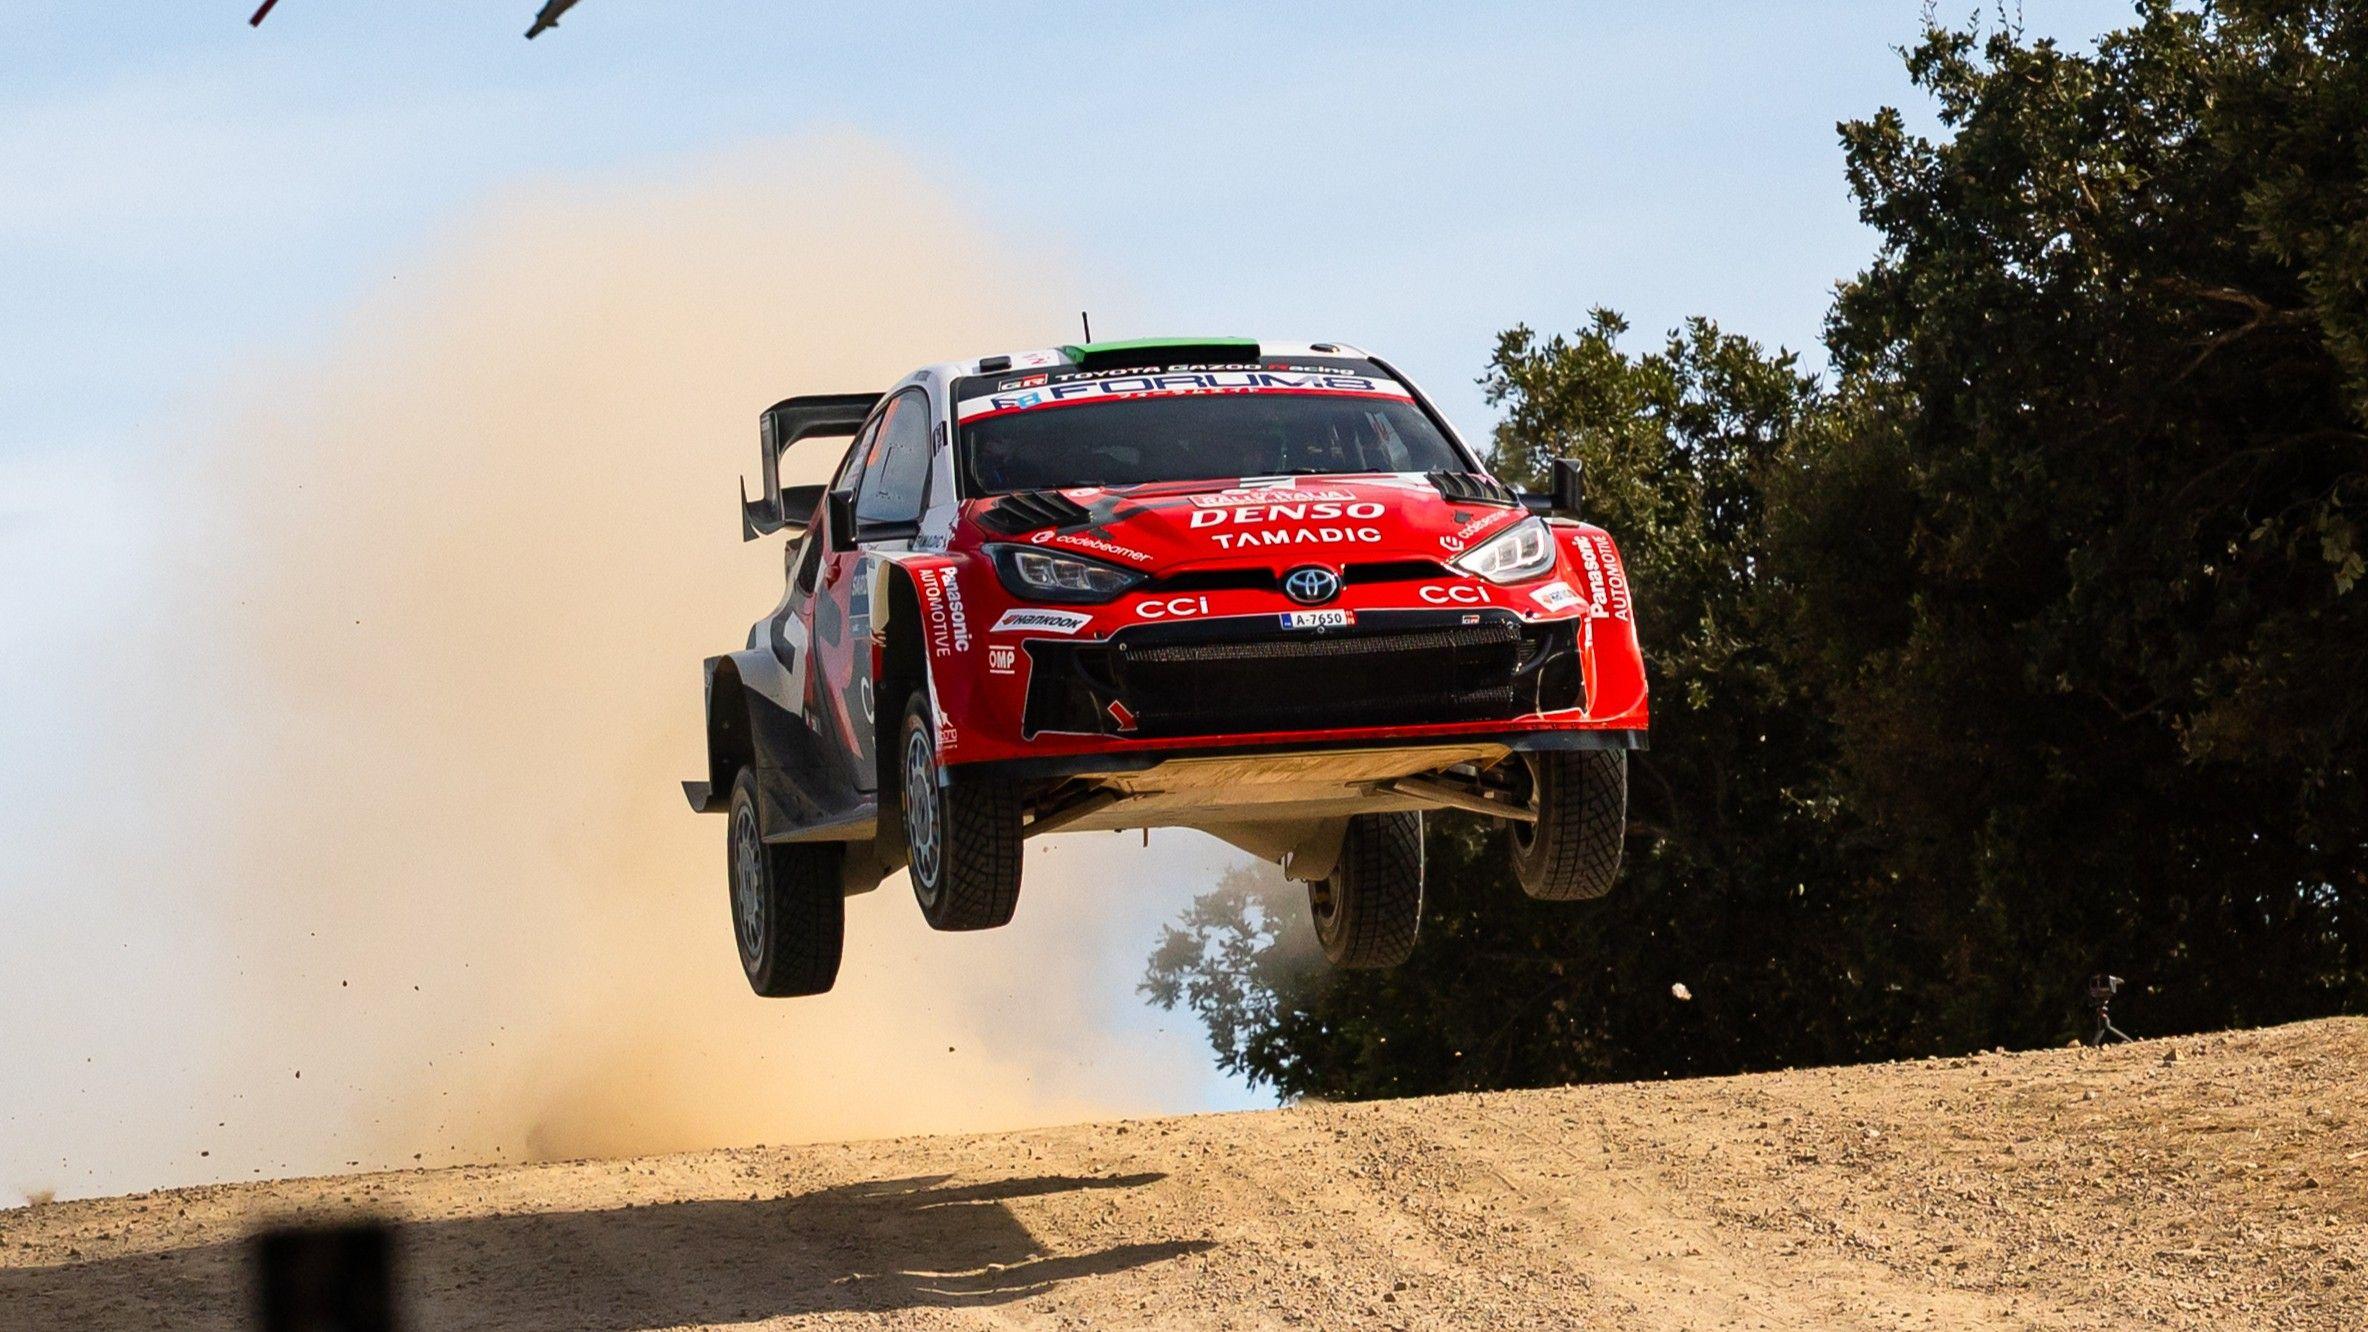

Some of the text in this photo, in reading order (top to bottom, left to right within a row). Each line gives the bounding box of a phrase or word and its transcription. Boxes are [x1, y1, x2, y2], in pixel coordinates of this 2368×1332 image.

[1000, 363, 1355, 391] GR TOYOTA GAZOO Racing
[1049, 373, 1376, 399] FORUM8
[1190, 503, 1386, 528] DENSO
[1056, 535, 1151, 562] codebeamer
[1211, 527, 1382, 549] TAMADIC
[1136, 596, 1208, 618] CCI
[1419, 585, 1491, 604] CCI
[918, 569, 951, 657] AUTOMOTIVE
[939, 566, 972, 652] Panasonic
[1296, 613, 1342, 625] A-7650
[989, 650, 1015, 668] OMP
